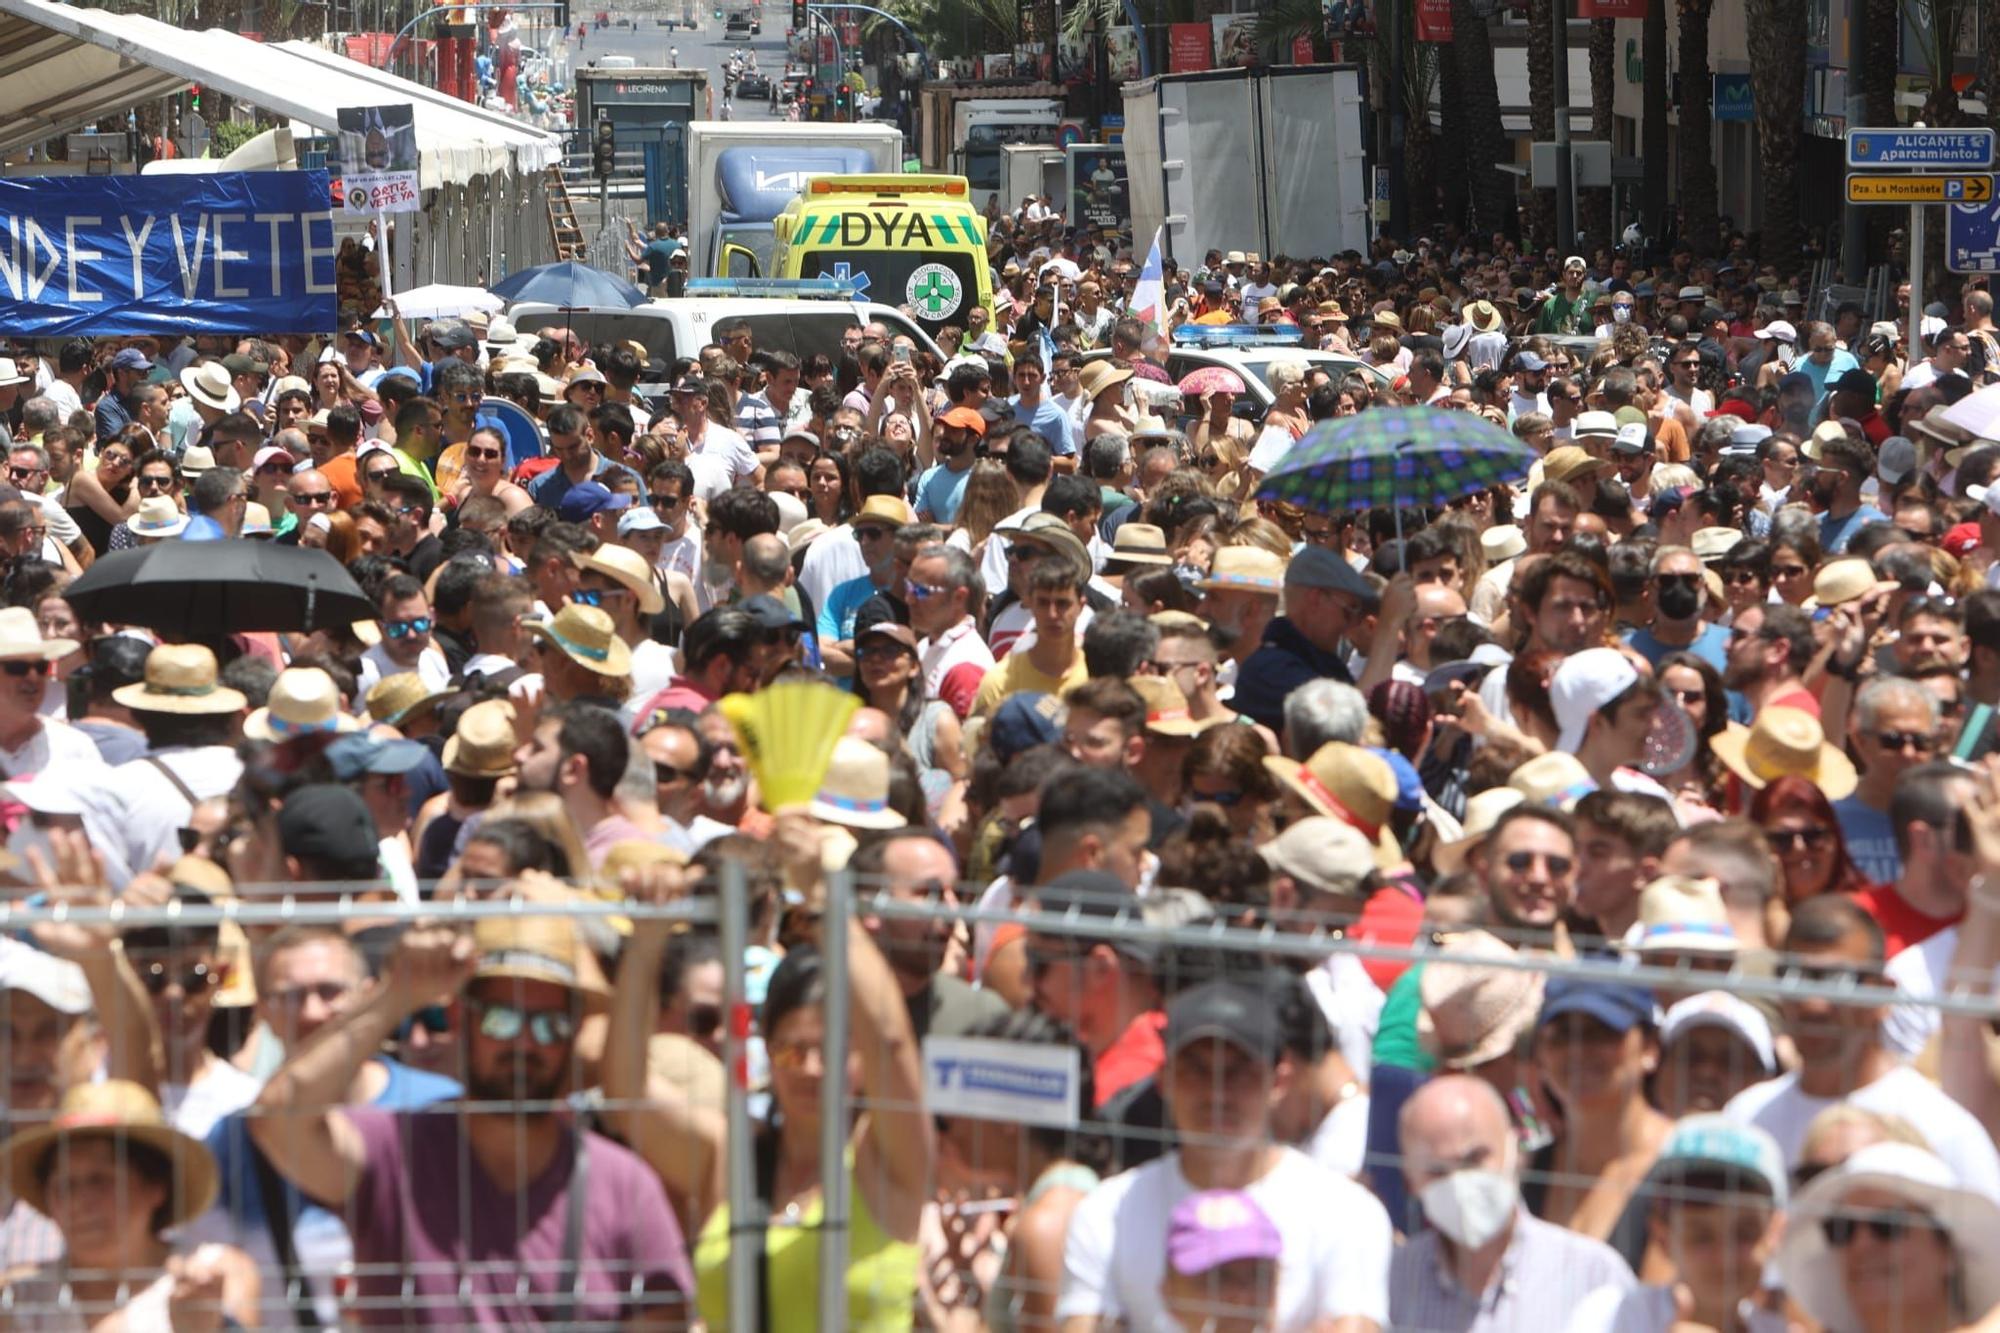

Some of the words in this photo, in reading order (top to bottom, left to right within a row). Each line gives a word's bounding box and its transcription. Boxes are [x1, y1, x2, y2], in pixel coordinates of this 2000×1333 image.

[628, 84, 668, 94] LECIÑENA
[1718, 103, 1753, 112] movista
[1895, 136, 1966, 147] ALICANTE
[1881, 149, 1980, 161] Aparcamientos
[371, 181, 408, 198] ORTIZ
[1853, 184, 1873, 193] Pza.
[1876, 184, 1887, 193] La
[1890, 183, 1941, 194] Montañeta
[1948, 181, 1961, 197] P
[369, 194, 398, 209] VETE
[400, 190, 415, 201] YA
[841, 212, 934, 247] DYA
[119, 213, 156, 301] Y
[170, 210, 337, 301] VETE
